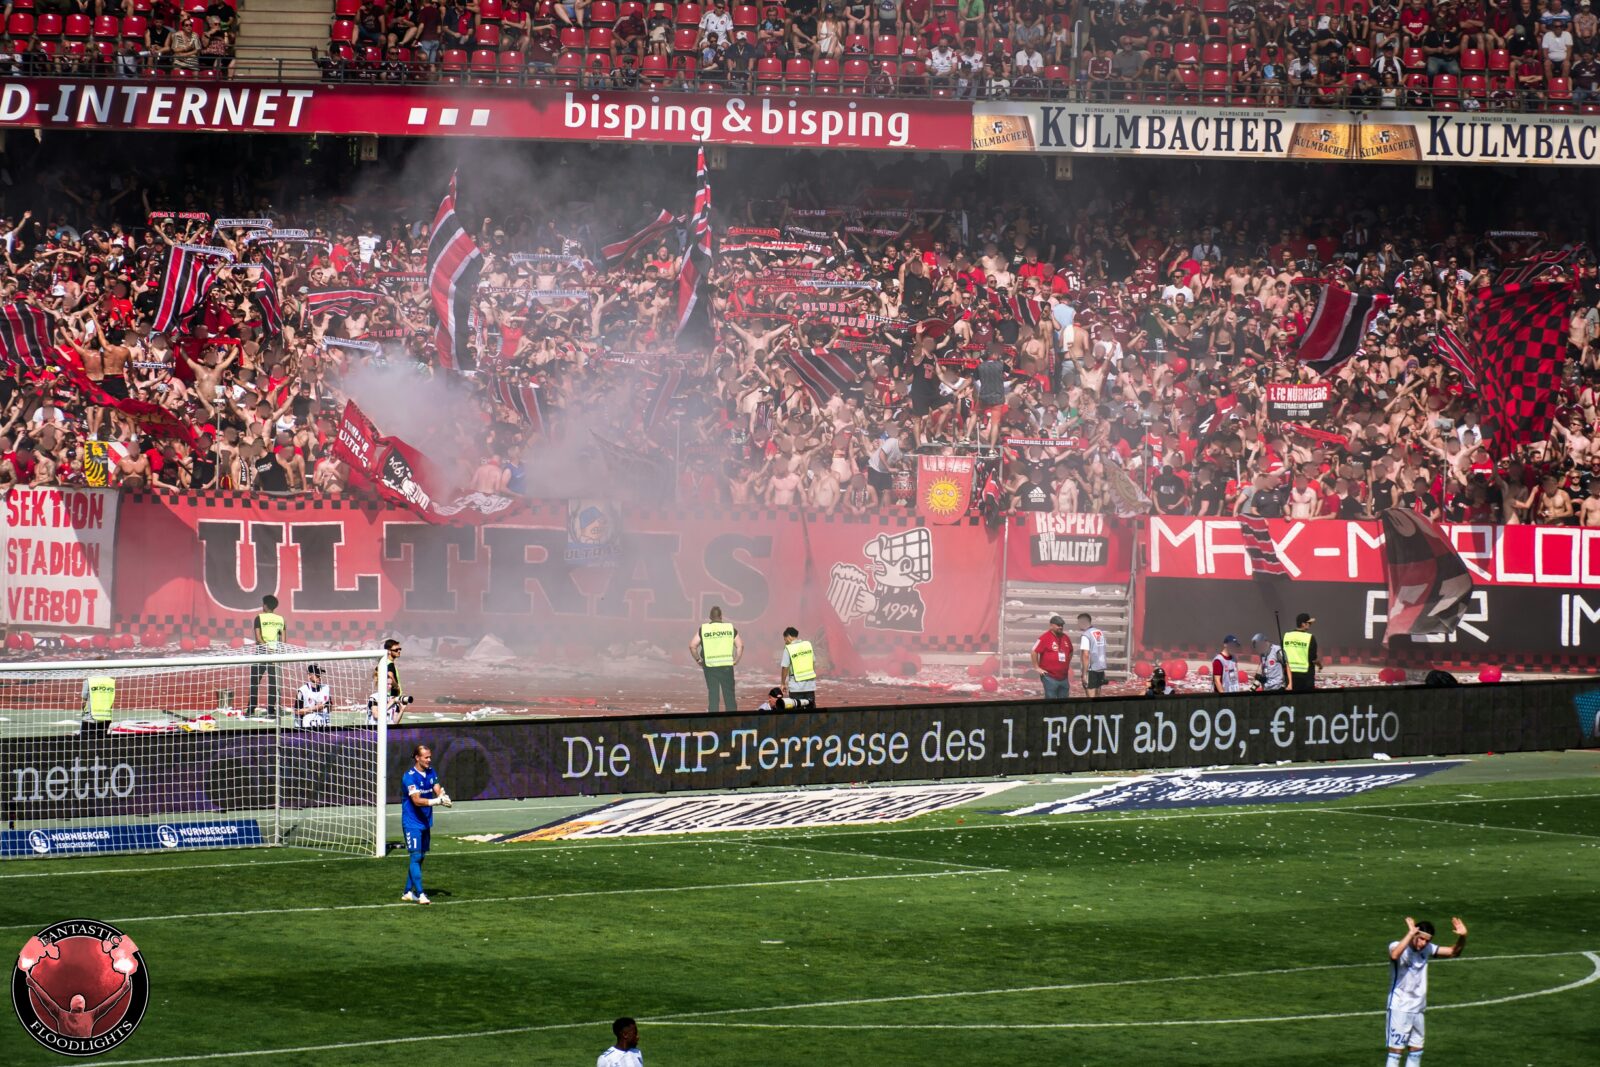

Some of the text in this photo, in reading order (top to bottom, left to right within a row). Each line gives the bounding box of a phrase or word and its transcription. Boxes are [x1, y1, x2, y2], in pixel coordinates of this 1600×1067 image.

[0, 83, 313, 127] D-INTERNET
[565, 92, 910, 147] bisping & bisping
[972, 130, 1028, 149] KULMBACHER
[1040, 106, 1284, 152] KULMBACHER
[1360, 138, 1415, 159] KULMBACHER
[1276, 387, 1287, 400] FC
[1287, 385, 1328, 401] NÜRNBERG
[7, 488, 104, 530] SEKTION
[1035, 511, 1104, 535] RESPEKT
[7, 538, 100, 577] STADION
[1038, 538, 1103, 562] RIVALITÄT
[198, 518, 774, 624] ULTRAS
[7, 587, 99, 626] VERBOT
[882, 602, 918, 621] 1994
[1364, 590, 1490, 643] FR
[562, 735, 630, 779] Die
[643, 728, 908, 776] VIP-Terrasse
[920, 721, 986, 763] des
[1001, 718, 1029, 759] 1.
[1042, 714, 1125, 758] FCN
[1133, 712, 1177, 754] ab
[1270, 705, 1295, 748] €
[1304, 704, 1400, 745] netto
[12, 755, 135, 802] netto
[51, 830, 110, 841] NÜRNBERGER
[179, 825, 238, 835] NÜRNBERGER
[412, 838, 417, 849] 1
[1395, 1033, 1408, 1046] 24
